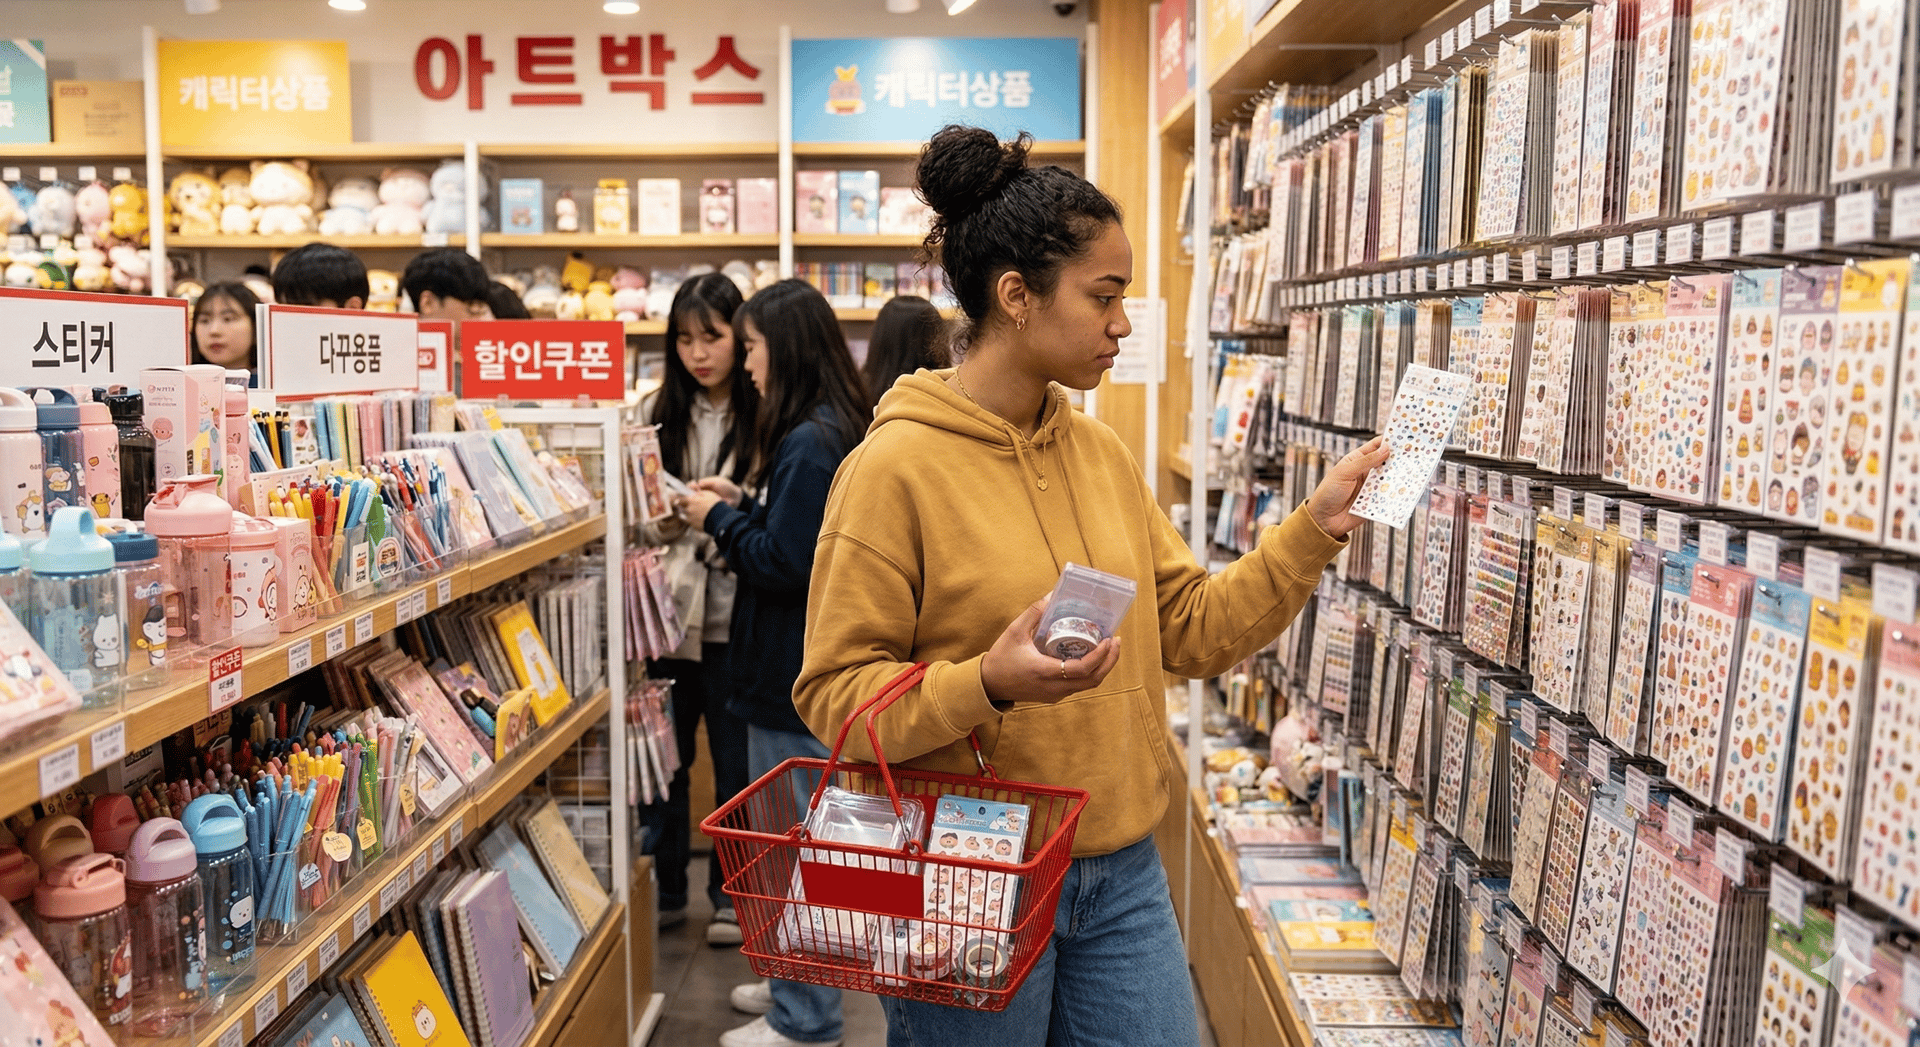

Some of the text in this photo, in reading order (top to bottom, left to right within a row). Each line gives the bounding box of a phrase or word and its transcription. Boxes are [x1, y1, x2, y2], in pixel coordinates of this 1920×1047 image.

[415, 34, 764, 110] 아트박스
[874, 70, 1033, 108] 캐릭터상품
[179, 74, 331, 112] 캐릭터상품
[32, 321, 115, 374] 스티커
[320, 332, 382, 374] 다꾸용품
[475, 341, 613, 381] 할인쿠폰
